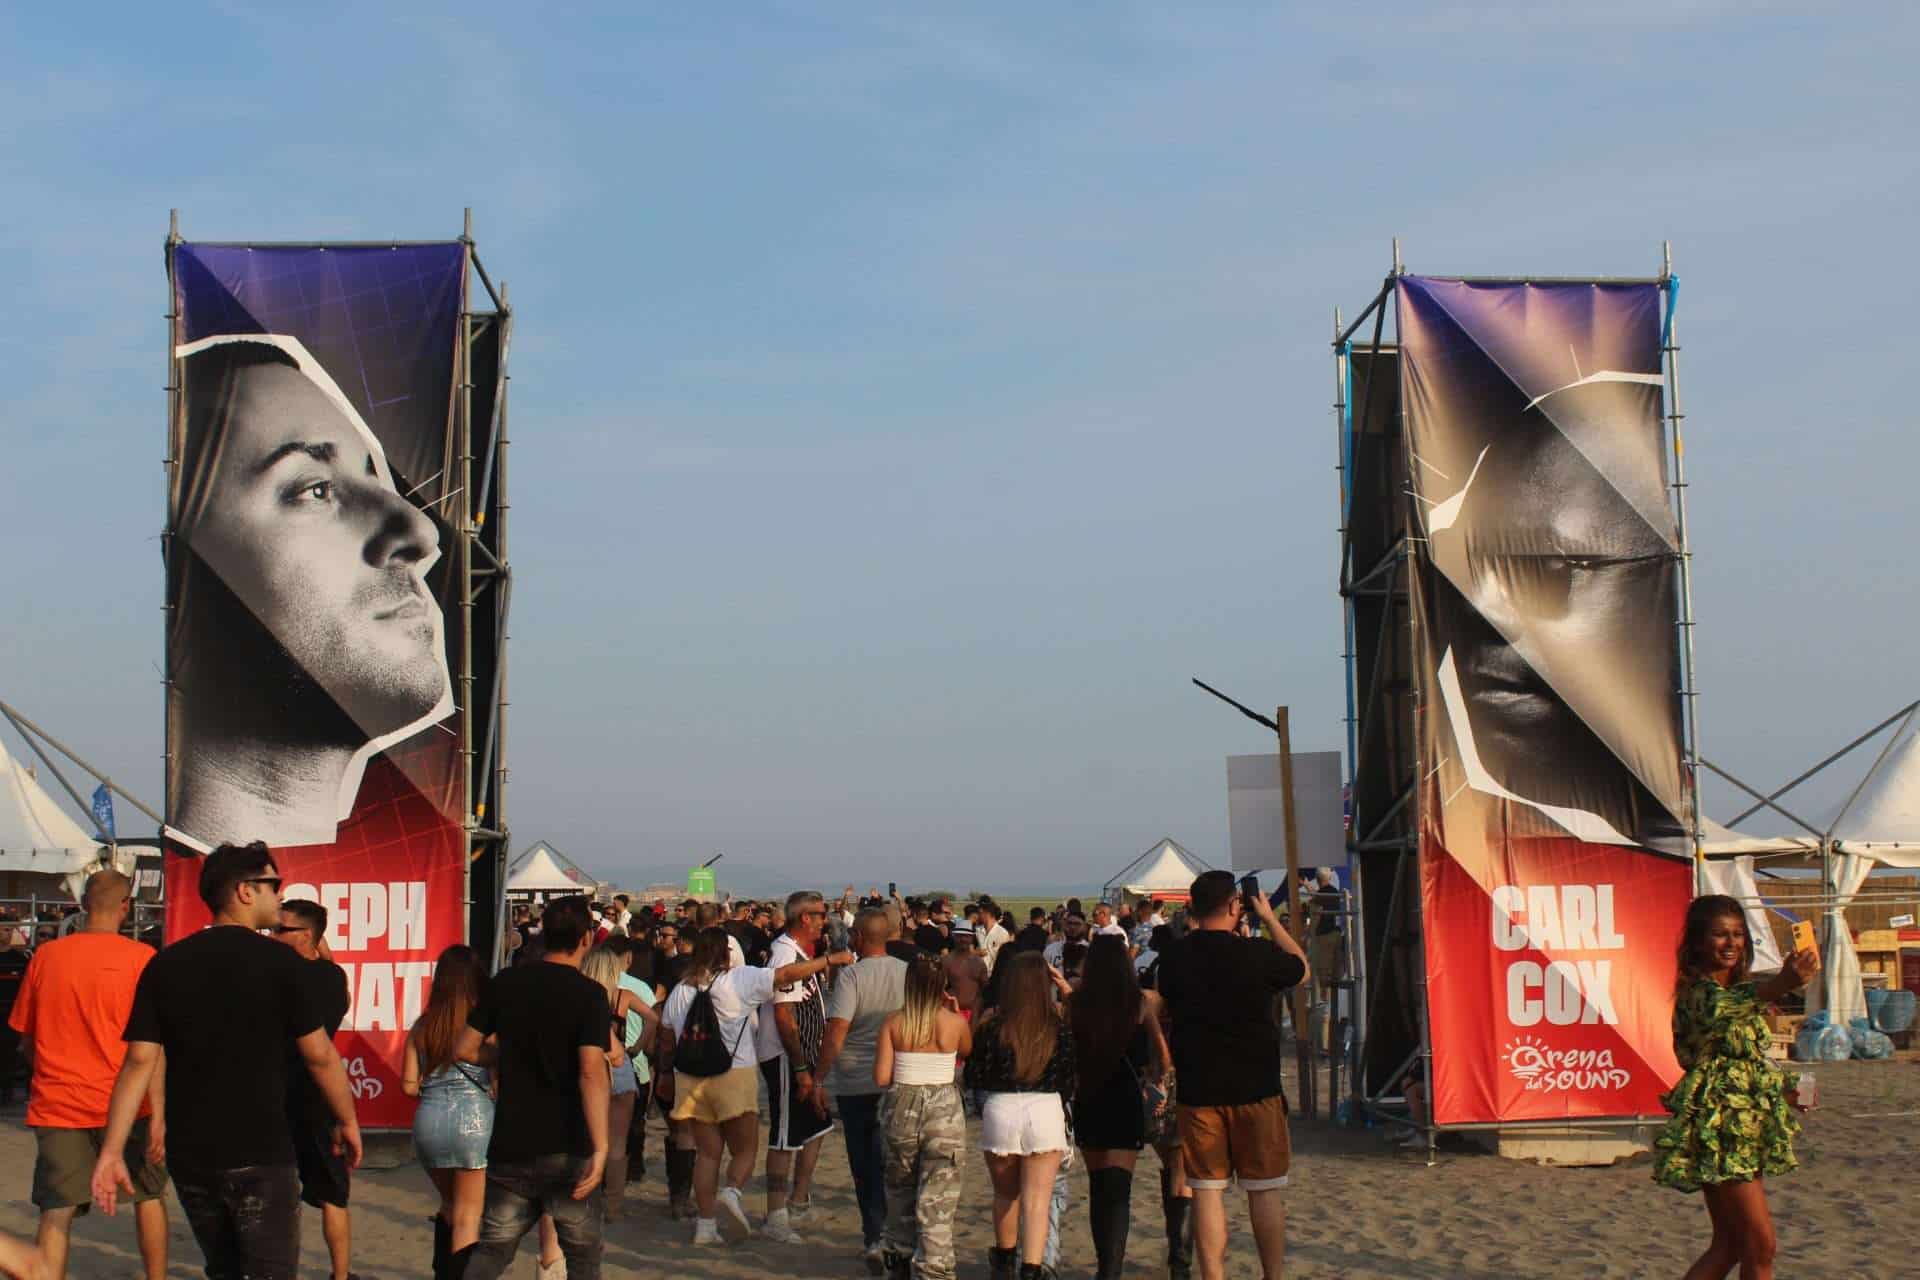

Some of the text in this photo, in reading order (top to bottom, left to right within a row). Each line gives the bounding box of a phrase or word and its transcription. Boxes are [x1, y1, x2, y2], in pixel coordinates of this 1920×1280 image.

[1492, 884, 1625, 951] CARL
[1507, 960, 1619, 1026] COX
[1543, 1068, 1631, 1093] SOUND
